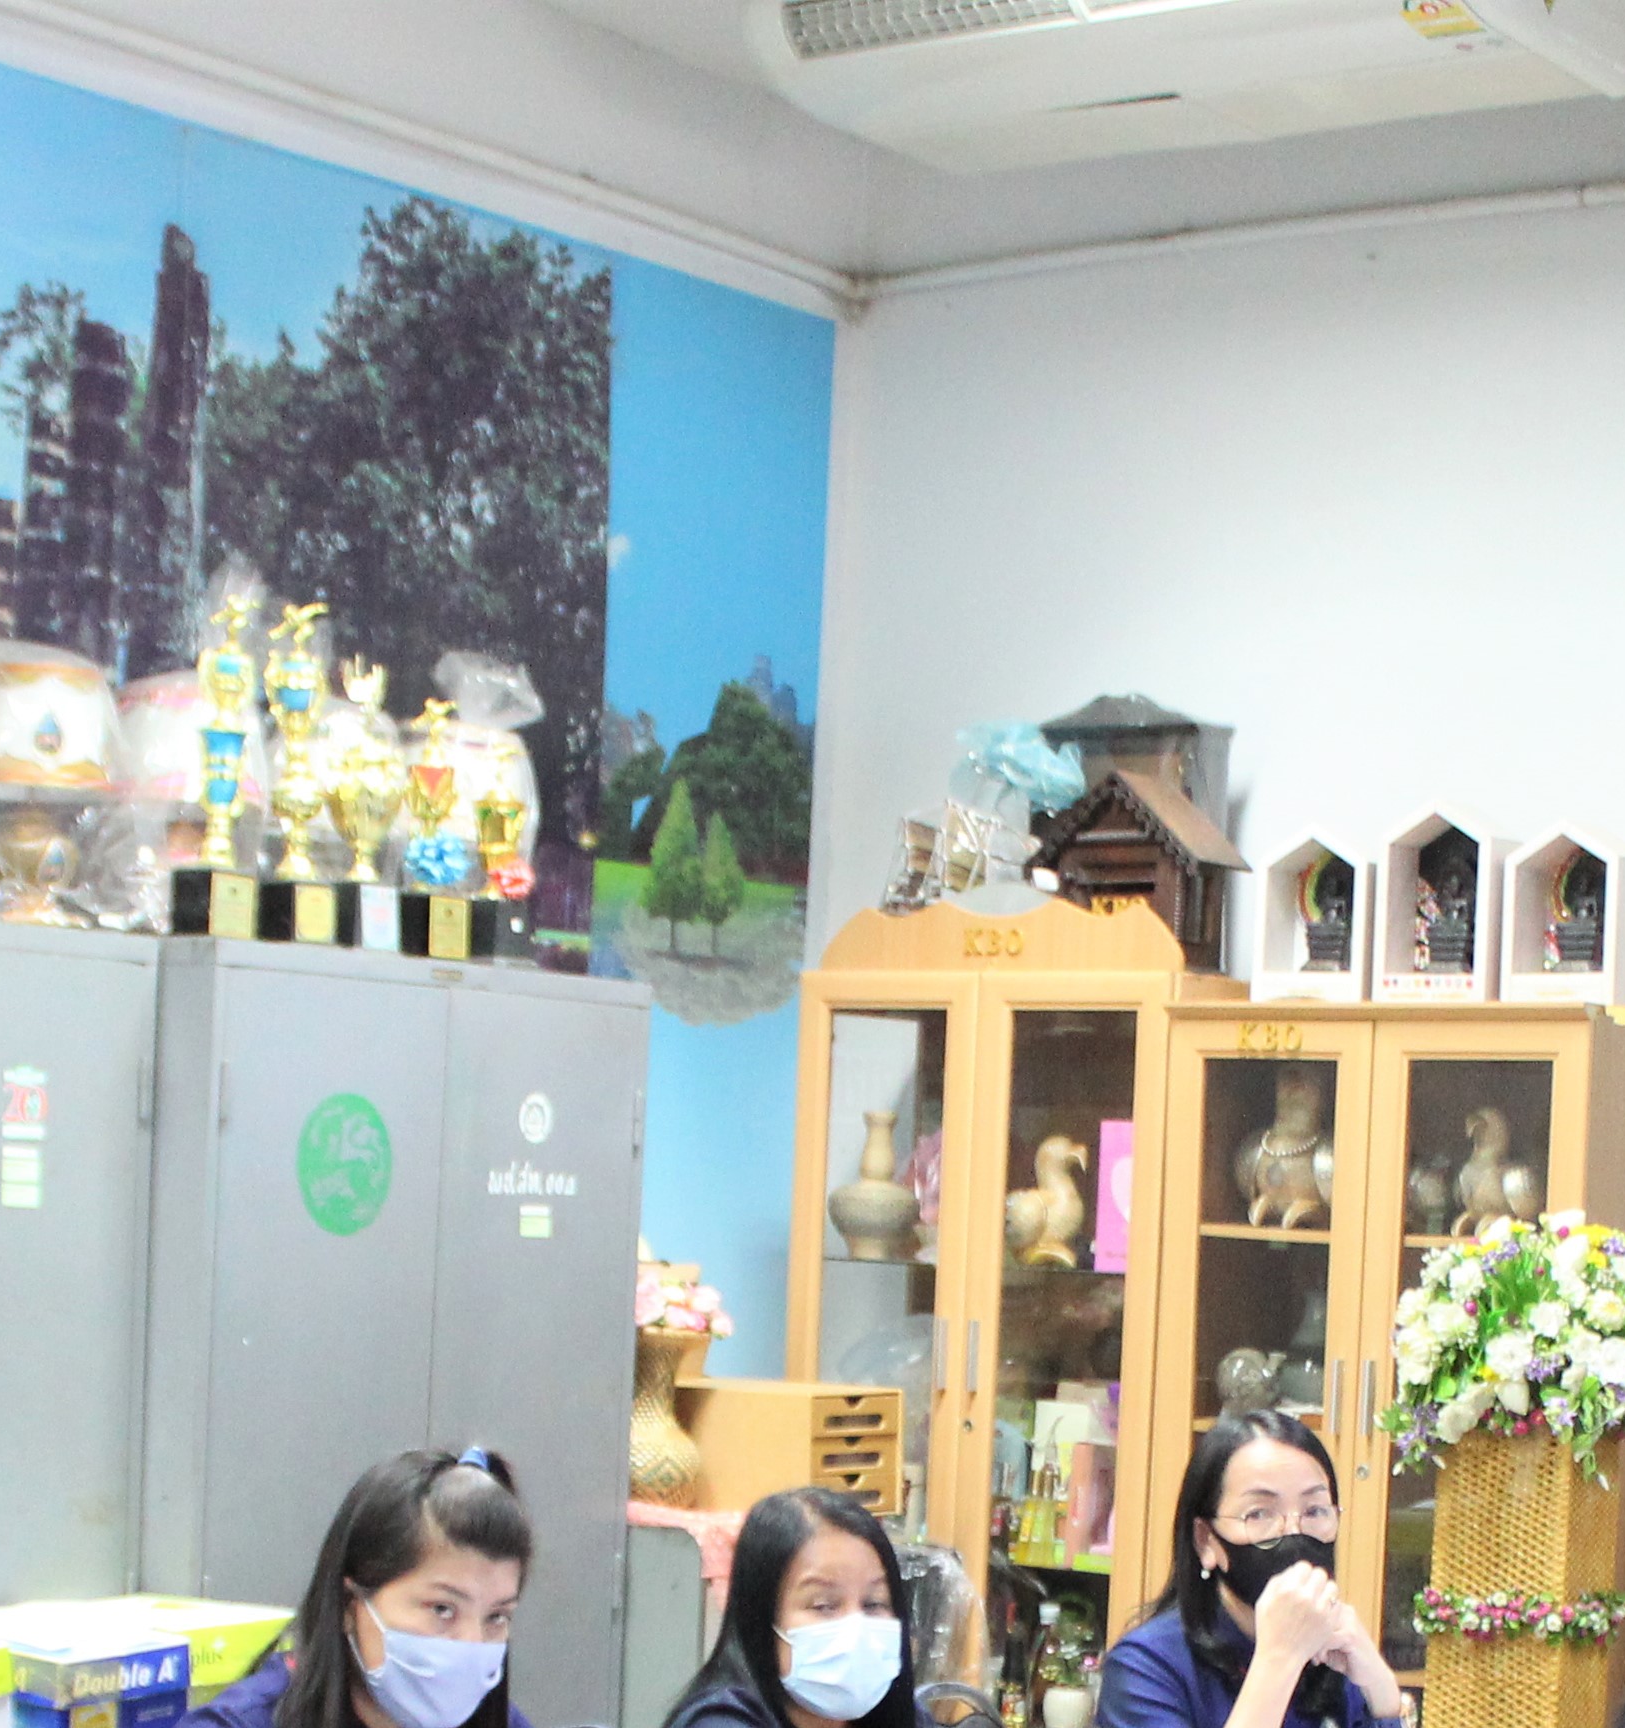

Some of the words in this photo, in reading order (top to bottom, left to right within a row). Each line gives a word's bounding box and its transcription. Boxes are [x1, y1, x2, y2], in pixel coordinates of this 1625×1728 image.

[1236, 1021, 1304, 1052] KBO
[72, 1661, 152, 1694] Double
[156, 1655, 176, 1684] A
